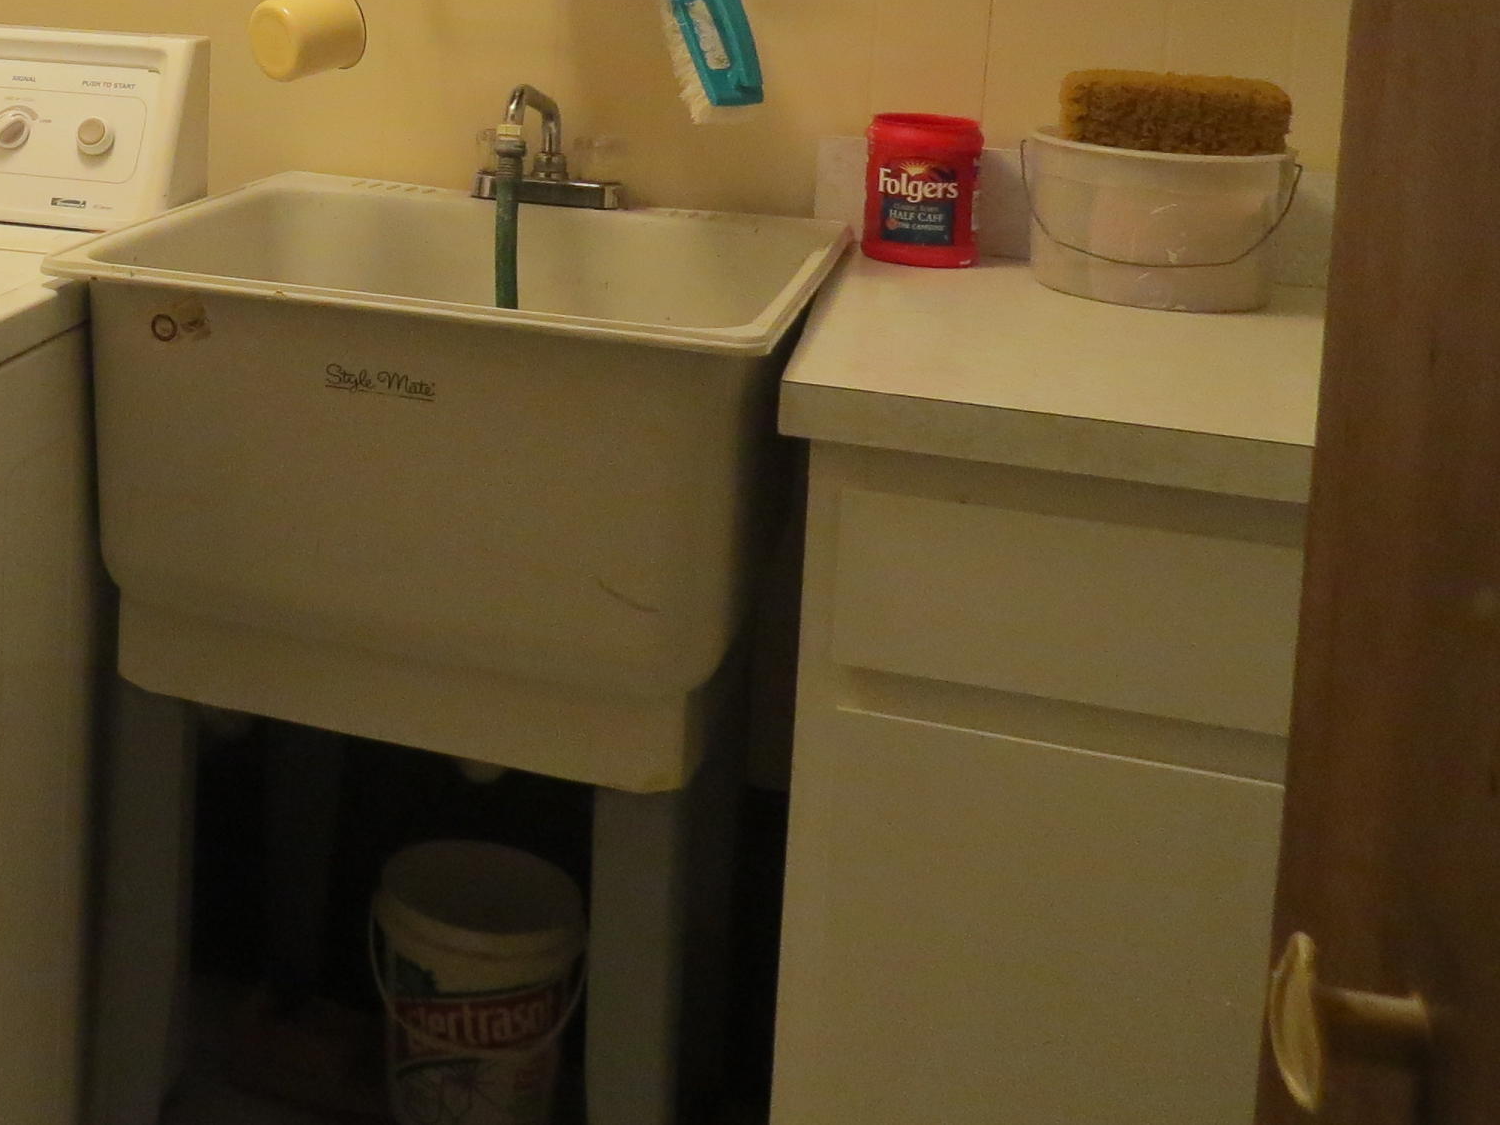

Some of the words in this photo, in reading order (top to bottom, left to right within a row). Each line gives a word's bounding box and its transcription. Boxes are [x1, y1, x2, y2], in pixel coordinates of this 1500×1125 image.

[82, 80, 101, 88] PUSH
[113, 82, 136, 90] START
[878, 167, 959, 203] Folgers
[889, 209, 915, 221] HALF
[325, 363, 375, 393] Style
[377, 370, 435, 397] Mate
